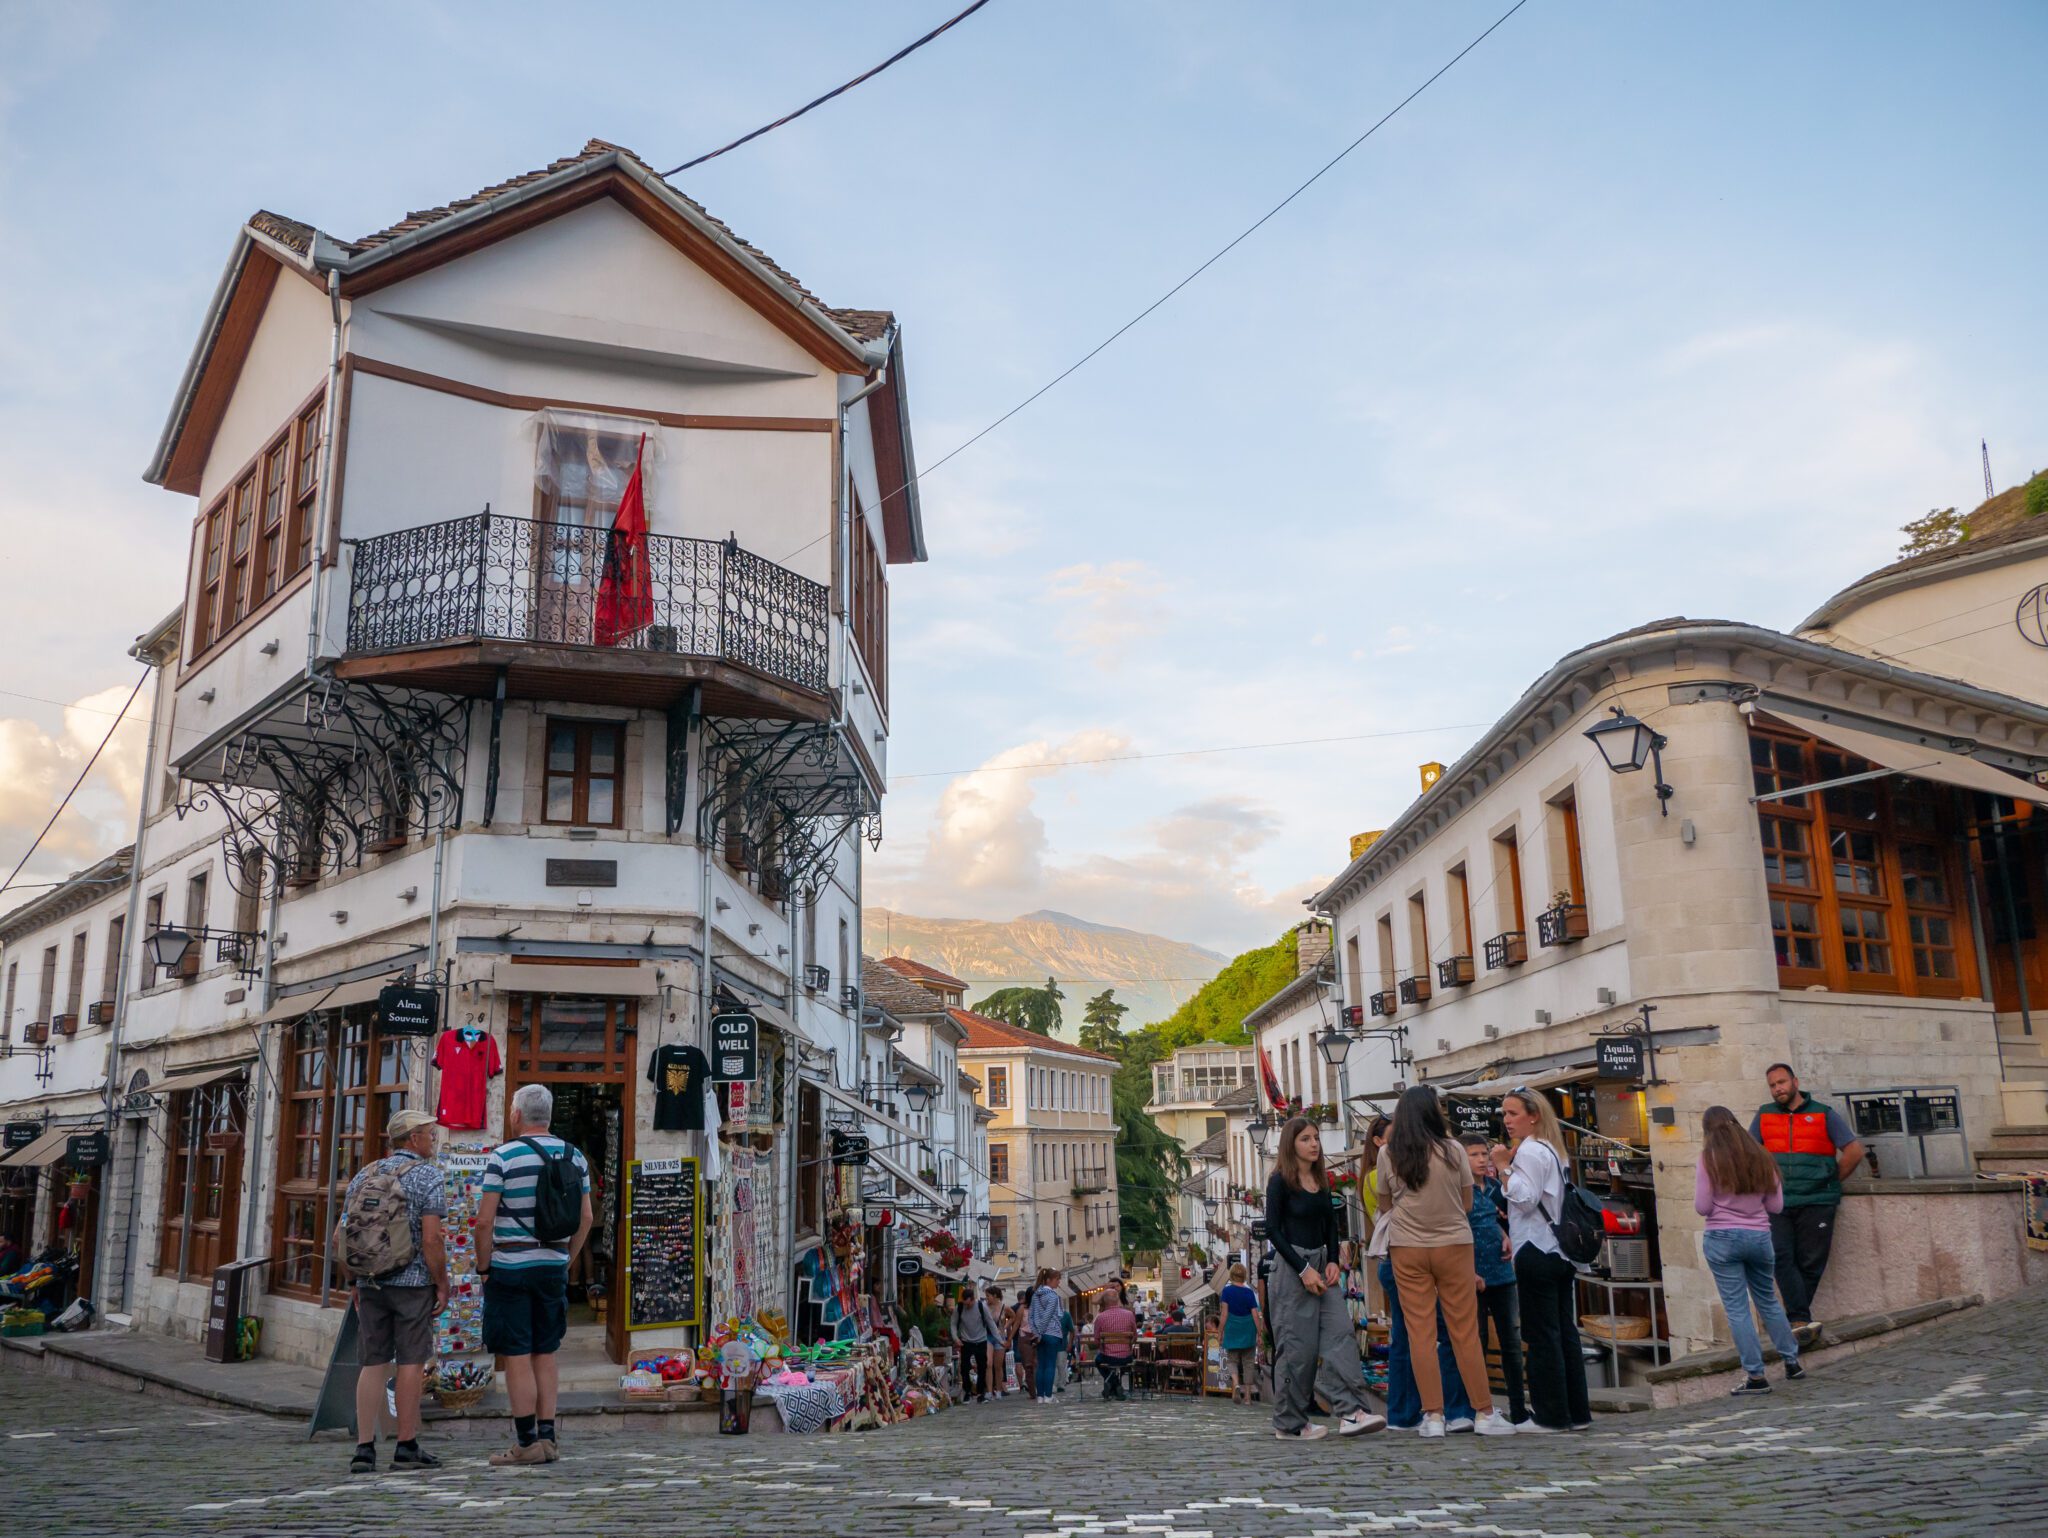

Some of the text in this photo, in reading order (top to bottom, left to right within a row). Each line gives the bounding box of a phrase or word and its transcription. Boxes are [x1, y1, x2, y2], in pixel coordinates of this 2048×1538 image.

[396, 999, 422, 1010] Alma
[388, 1012, 430, 1024] Souvenir
[718, 1022, 749, 1034] OLD
[718, 1039, 750, 1051] WELL
[1604, 1044, 1635, 1055] Aquila
[1603, 1054, 1637, 1064] Liquori
[1470, 1113, 1479, 1121] &
[1460, 1120, 1490, 1129] Carpet
[451, 1157, 490, 1166] MAGNET
[644, 1160, 680, 1171] SILVER 925
[216, 1279, 226, 1291] OLD
[214, 1295, 225, 1307] WELL
